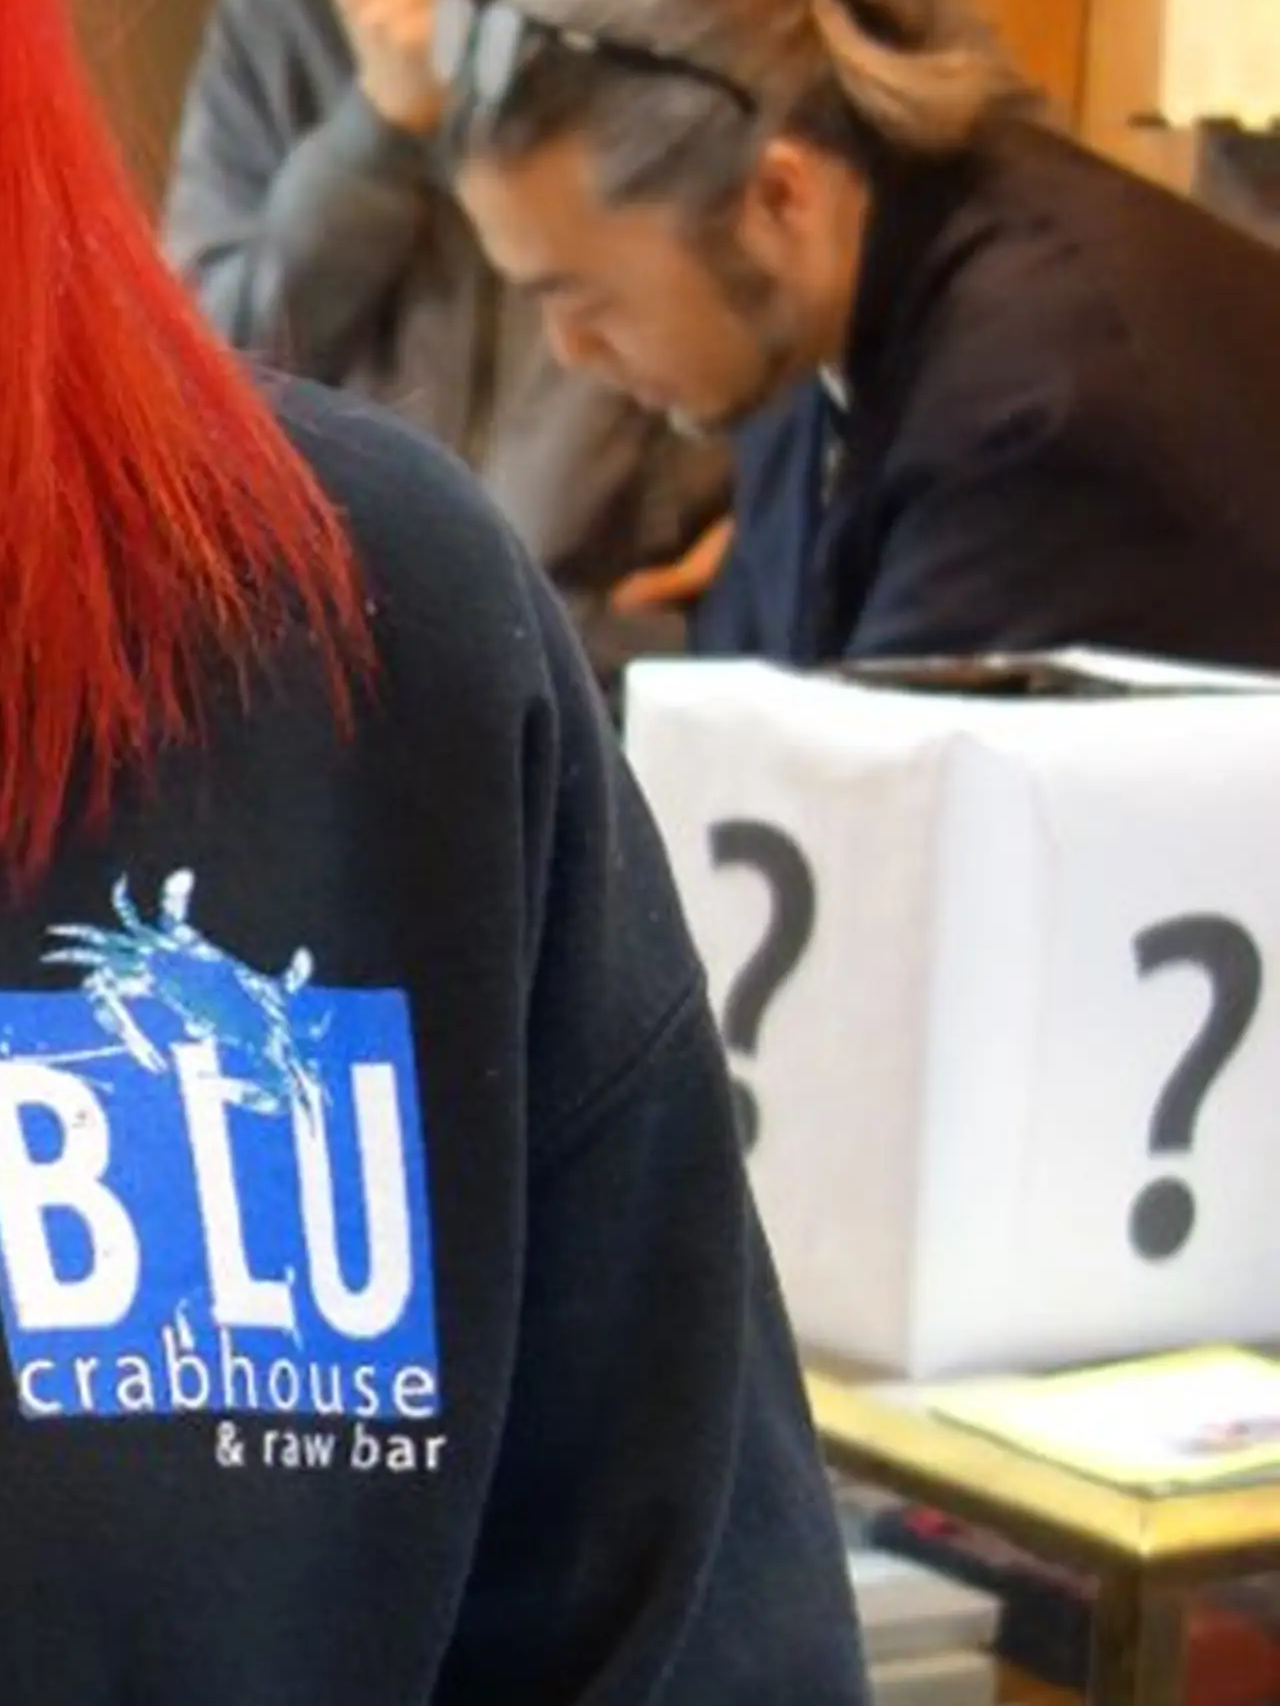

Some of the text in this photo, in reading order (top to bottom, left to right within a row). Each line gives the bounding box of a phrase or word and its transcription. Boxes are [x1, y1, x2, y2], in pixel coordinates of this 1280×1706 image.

[1126, 911, 1264, 1265] ?
[17, 1323, 436, 1418] crabhouse
[214, 1420, 446, 1472] & raw bar
